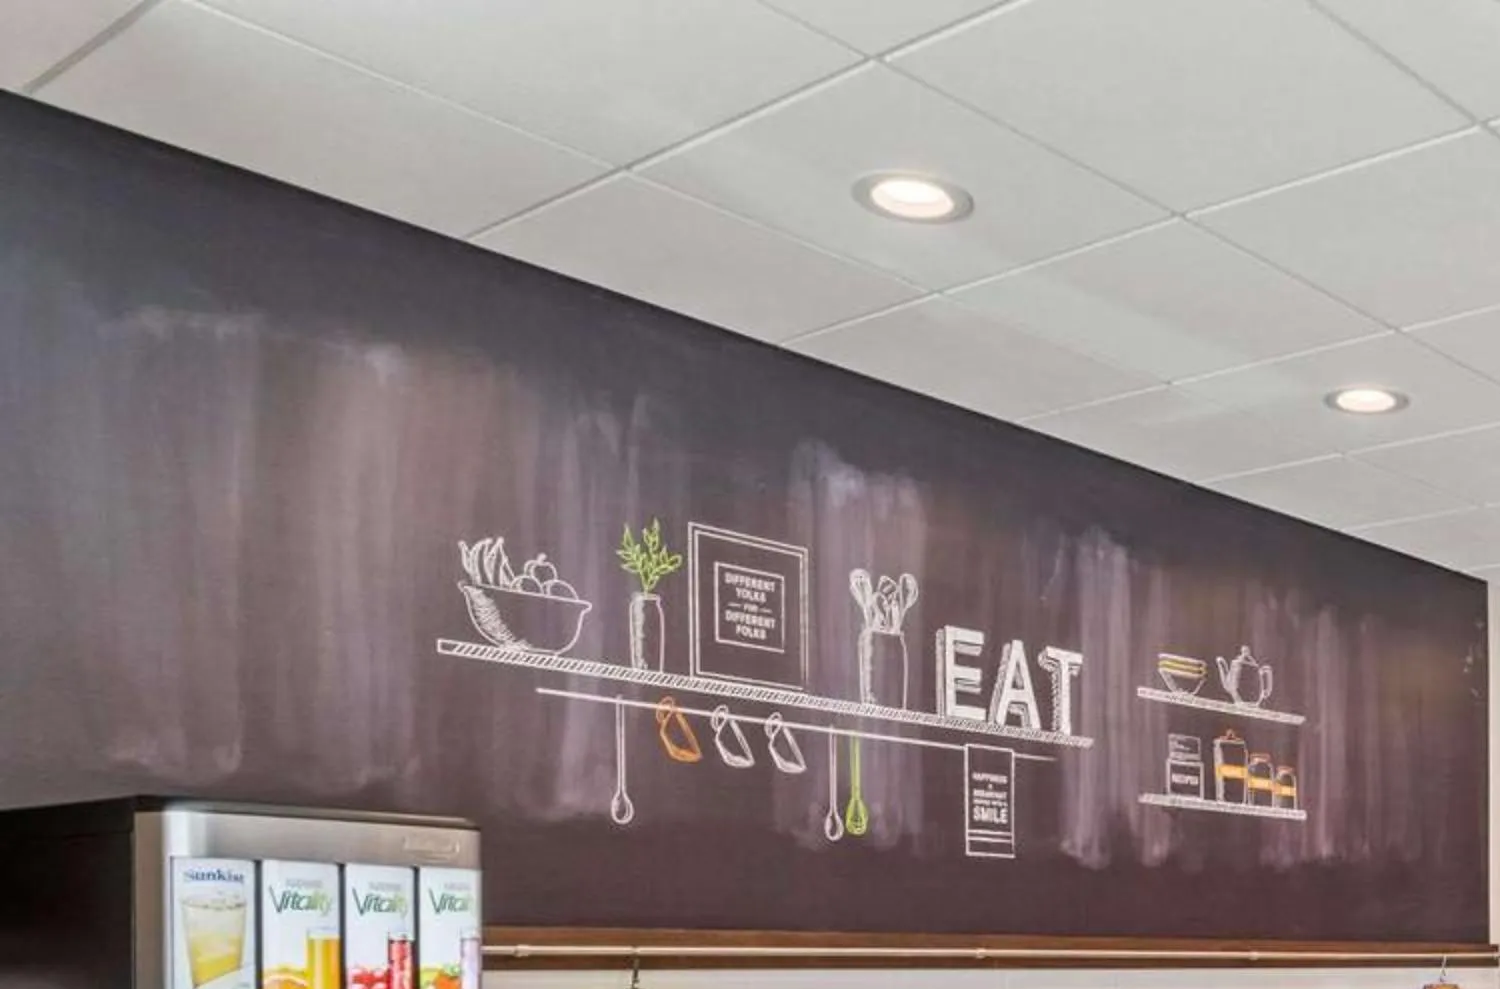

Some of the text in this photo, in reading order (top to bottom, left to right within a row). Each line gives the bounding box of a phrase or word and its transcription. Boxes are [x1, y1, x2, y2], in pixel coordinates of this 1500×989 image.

[725, 572, 775, 592] DIFFERENT
[735, 587, 767, 603] YOLKS
[725, 610, 776, 629] DIFFERENT
[735, 624, 767, 640] FOLKS
[935, 625, 1084, 736] EAT
[973, 806, 1008, 824] SMILE
[268, 884, 332, 917] Vitality
[428, 887, 475, 916] Vita
